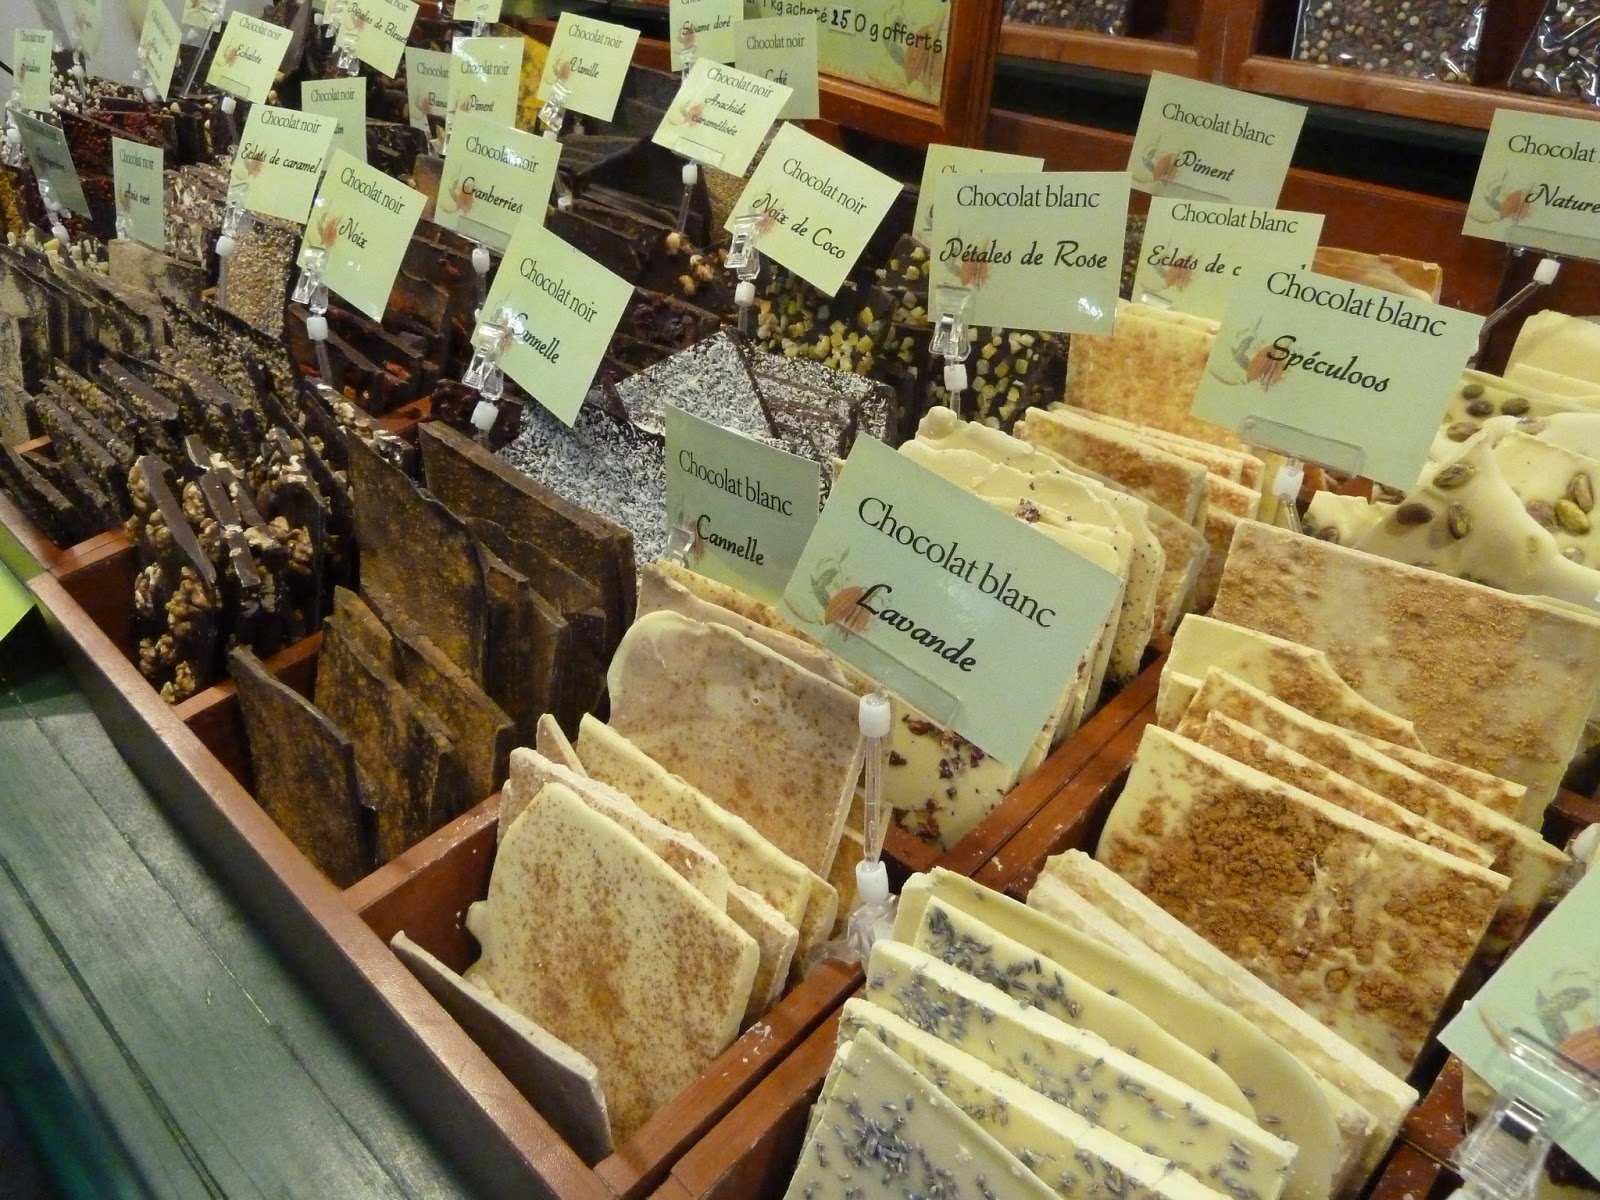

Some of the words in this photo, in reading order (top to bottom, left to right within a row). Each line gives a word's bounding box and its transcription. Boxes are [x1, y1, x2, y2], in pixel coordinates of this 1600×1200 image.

[239, 16, 267, 36] Chocolat
[266, 29, 282, 41] noir
[374, 17, 383, 30] de
[568, 23, 604, 45] Chocolat
[604, 34, 623, 49] noir
[682, 20, 711, 36] Sésame
[713, 15, 731, 28] doré
[870, 23, 879, 42] g
[882, 24, 943, 53] offerts
[235, 44, 263, 65] Echalote
[746, 34, 784, 50] Chocolat
[786, 33, 805, 48] noir
[417, 62, 450, 79] Chocolat
[460, 60, 493, 76] Chocolat
[493, 61, 510, 76] noir
[570, 56, 600, 79] Vanille
[706, 67, 750, 93] Chocolat
[750, 84, 774, 99] noir
[310, 88, 340, 102] Chocolat
[341, 87, 355, 100] noir
[466, 94, 495, 112] Piment
[704, 93, 746, 116] Arachide
[260, 109, 300, 130] Chocolat
[300, 119, 322, 134] noir
[691, 113, 738, 137] caramélisée
[1161, 101, 1231, 135] Chocolat
[1232, 117, 1276, 147] blanc
[240, 142, 267, 162] Eclats
[269, 148, 280, 165] de
[282, 157, 323, 174] caramel
[514, 154, 539, 174] noir
[1508, 134, 1597, 163] Chocolat
[1174, 149, 1235, 183] Piment
[340, 166, 383, 203] Chocolat
[383, 196, 405, 216] noir
[462, 176, 524, 214] Cranberries
[783, 157, 839, 200] Chocolat
[839, 191, 868, 215] noir
[956, 184, 1043, 207] Chocolat
[1045, 184, 1100, 208] blanc
[1524, 182, 1600, 214] Nature
[338, 217, 368, 249] Noix
[752, 192, 789, 225] Noix
[790, 217, 808, 237] de
[812, 227, 846, 259] Coco
[1171, 202, 1247, 229] Chocolat
[1249, 208, 1298, 235] blanc
[939, 237, 1012, 265] Pétales
[1020, 240, 1044, 267] de
[1053, 239, 1108, 269] Rose
[1146, 245, 1199, 271] Eclats
[1204, 252, 1226, 276] de
[519, 256, 572, 306] Chocolat
[569, 300, 598, 324] noir
[1266, 270, 1374, 319] Chocolat
[1375, 300, 1447, 339] blanc
[511, 312, 561, 365] Cannelle
[1267, 334, 1391, 393] Spéculoos
[678, 449, 745, 503] Chocolat
[745, 480, 793, 517] blanc
[695, 514, 765, 567] Cannelle
[857, 495, 979, 584] Chocolat
[979, 560, 1058, 630] blanc
[855, 582, 978, 673] Lavande
